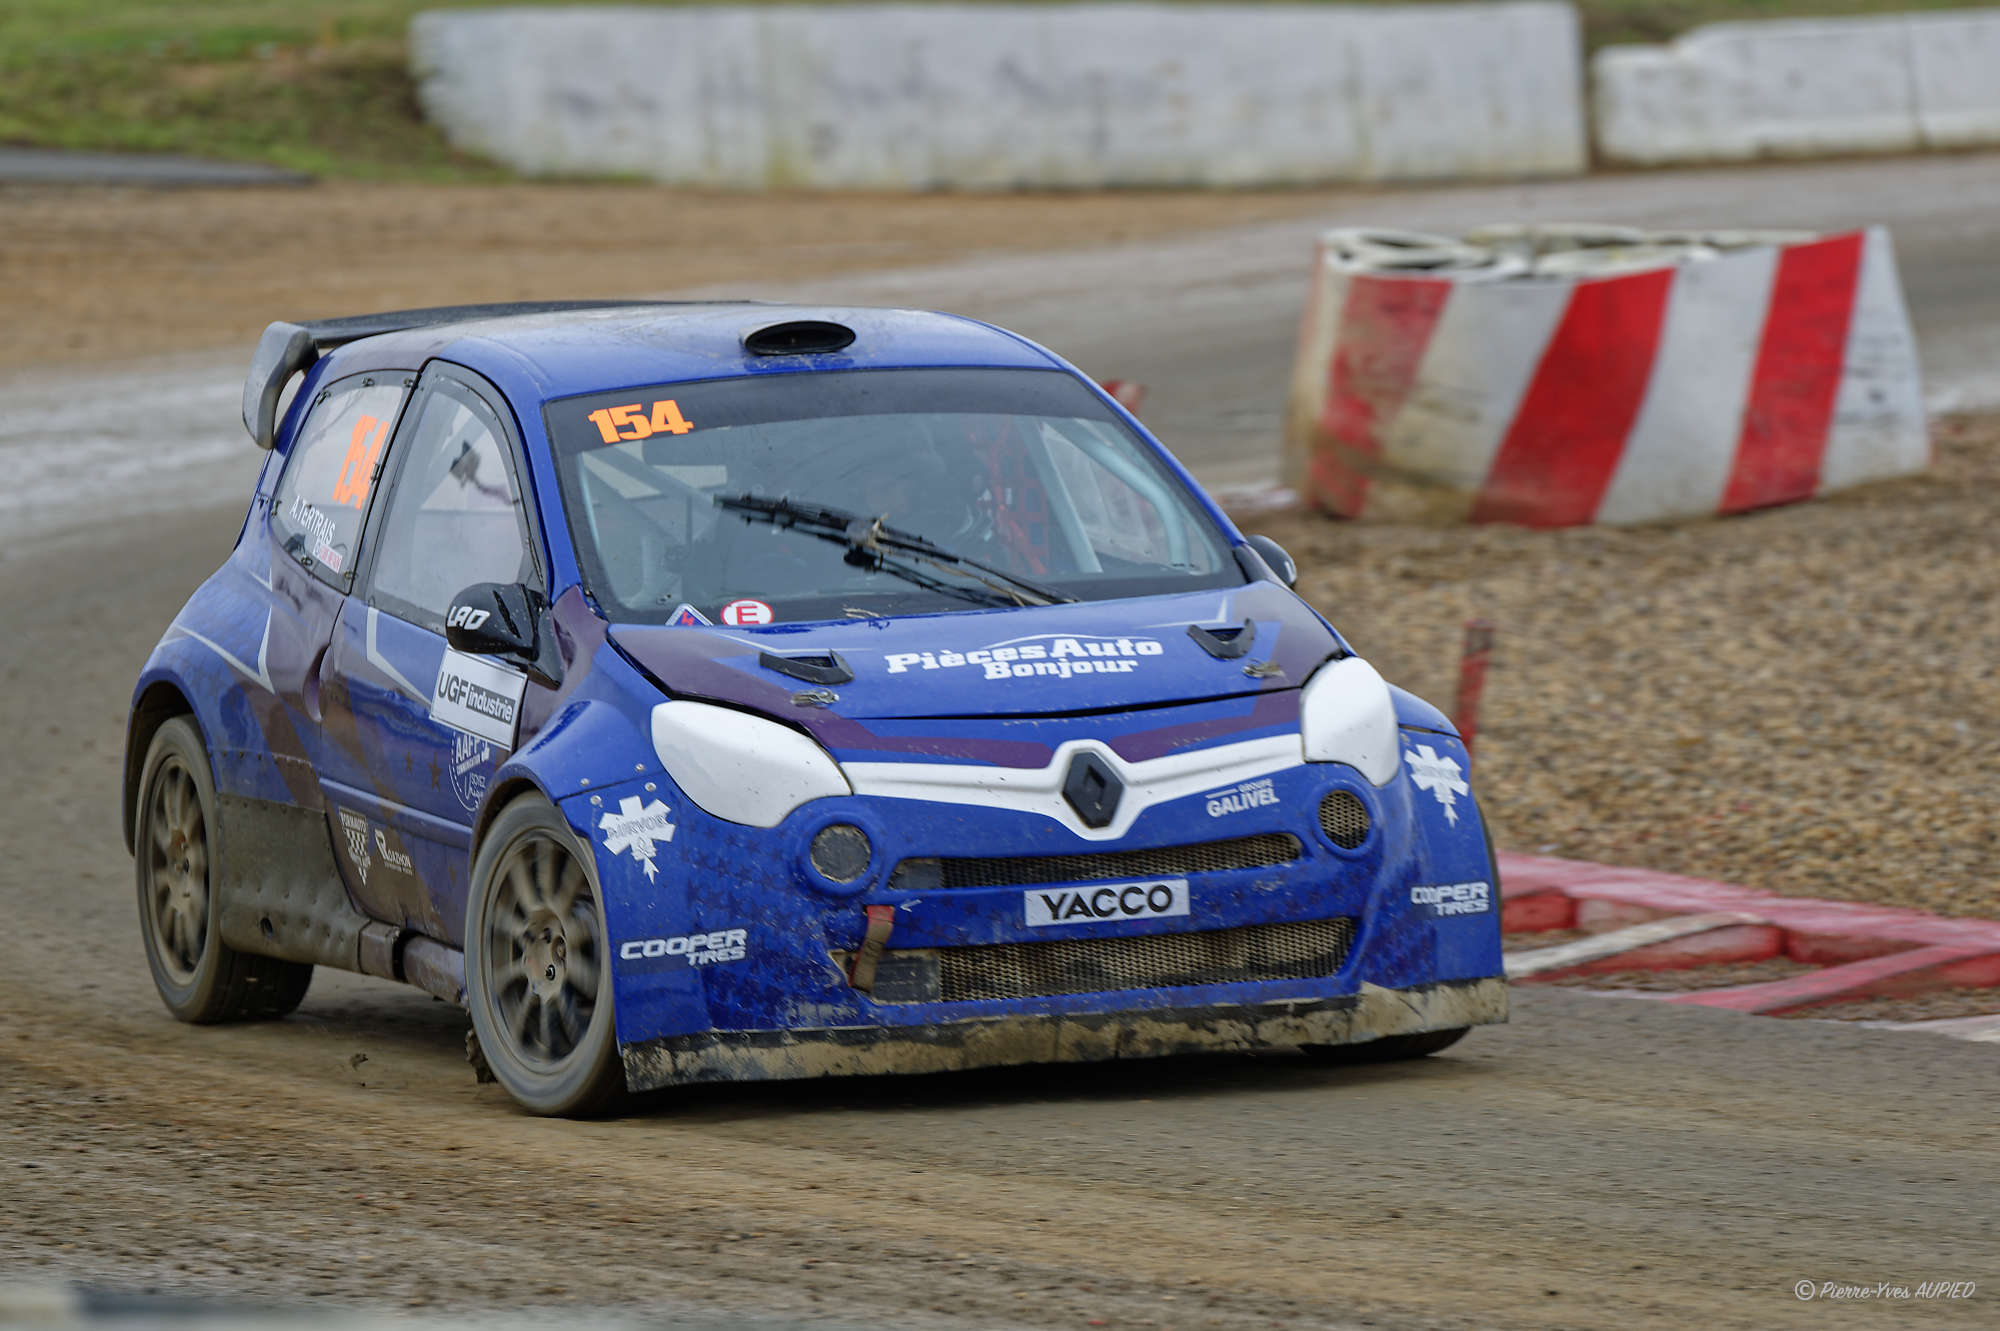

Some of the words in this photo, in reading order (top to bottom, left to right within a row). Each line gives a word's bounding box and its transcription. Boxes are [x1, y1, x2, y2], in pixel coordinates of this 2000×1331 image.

[587, 400, 694, 444] 154
[332, 414, 389, 511] 154
[884, 644, 1047, 674] Pièces
[1050, 638, 1164, 658] Auto
[984, 657, 1139, 681] Bonjour
[438, 671, 469, 705] UGF
[468, 685, 513, 722] industrie
[1040, 884, 1173, 921] YACCO
[1434, 899, 1490, 916] TIRES
[620, 928, 748, 960] COOPER
[686, 945, 747, 967] TIRES
